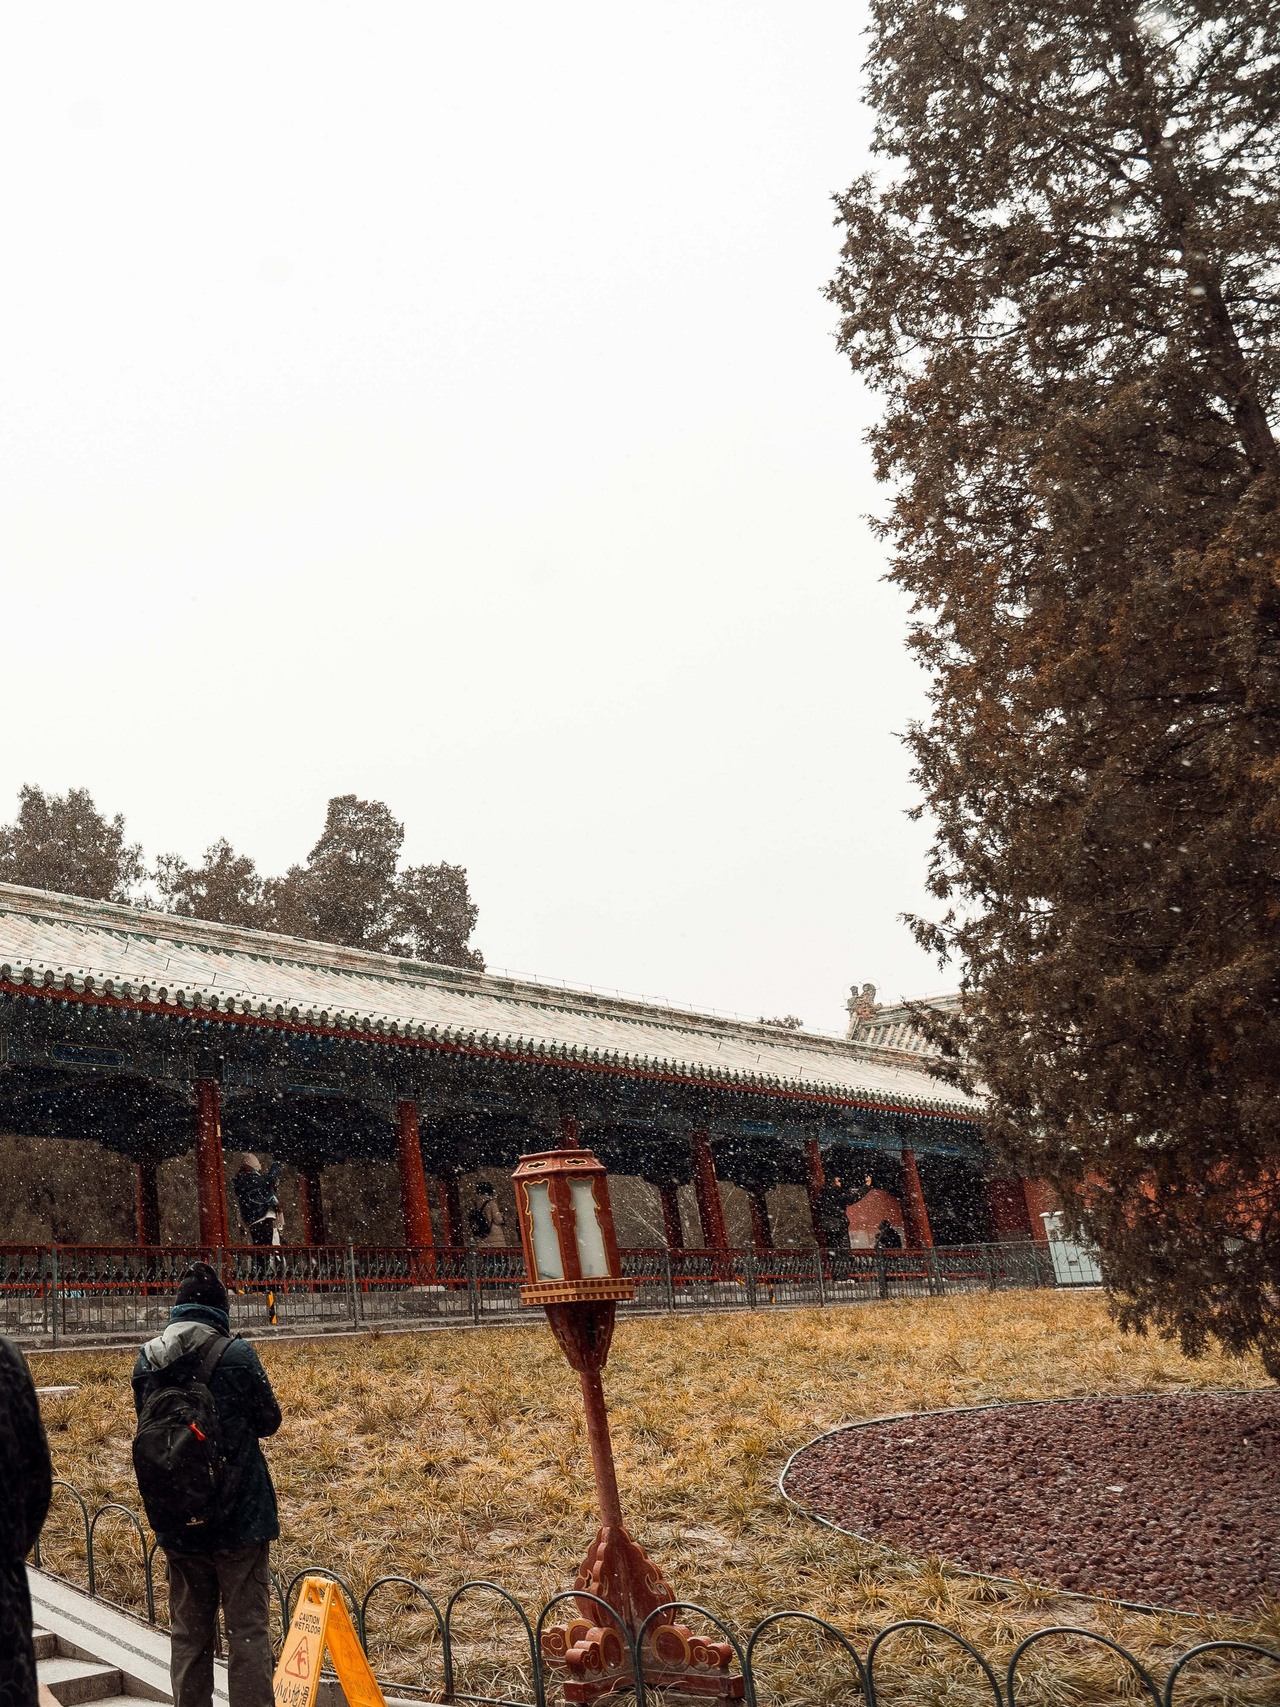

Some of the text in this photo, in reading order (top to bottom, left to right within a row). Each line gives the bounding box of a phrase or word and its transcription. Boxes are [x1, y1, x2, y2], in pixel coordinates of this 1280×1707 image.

[299, 1612, 320, 1625] CAUTION
[295, 1621, 321, 1635] WET FLOOR
